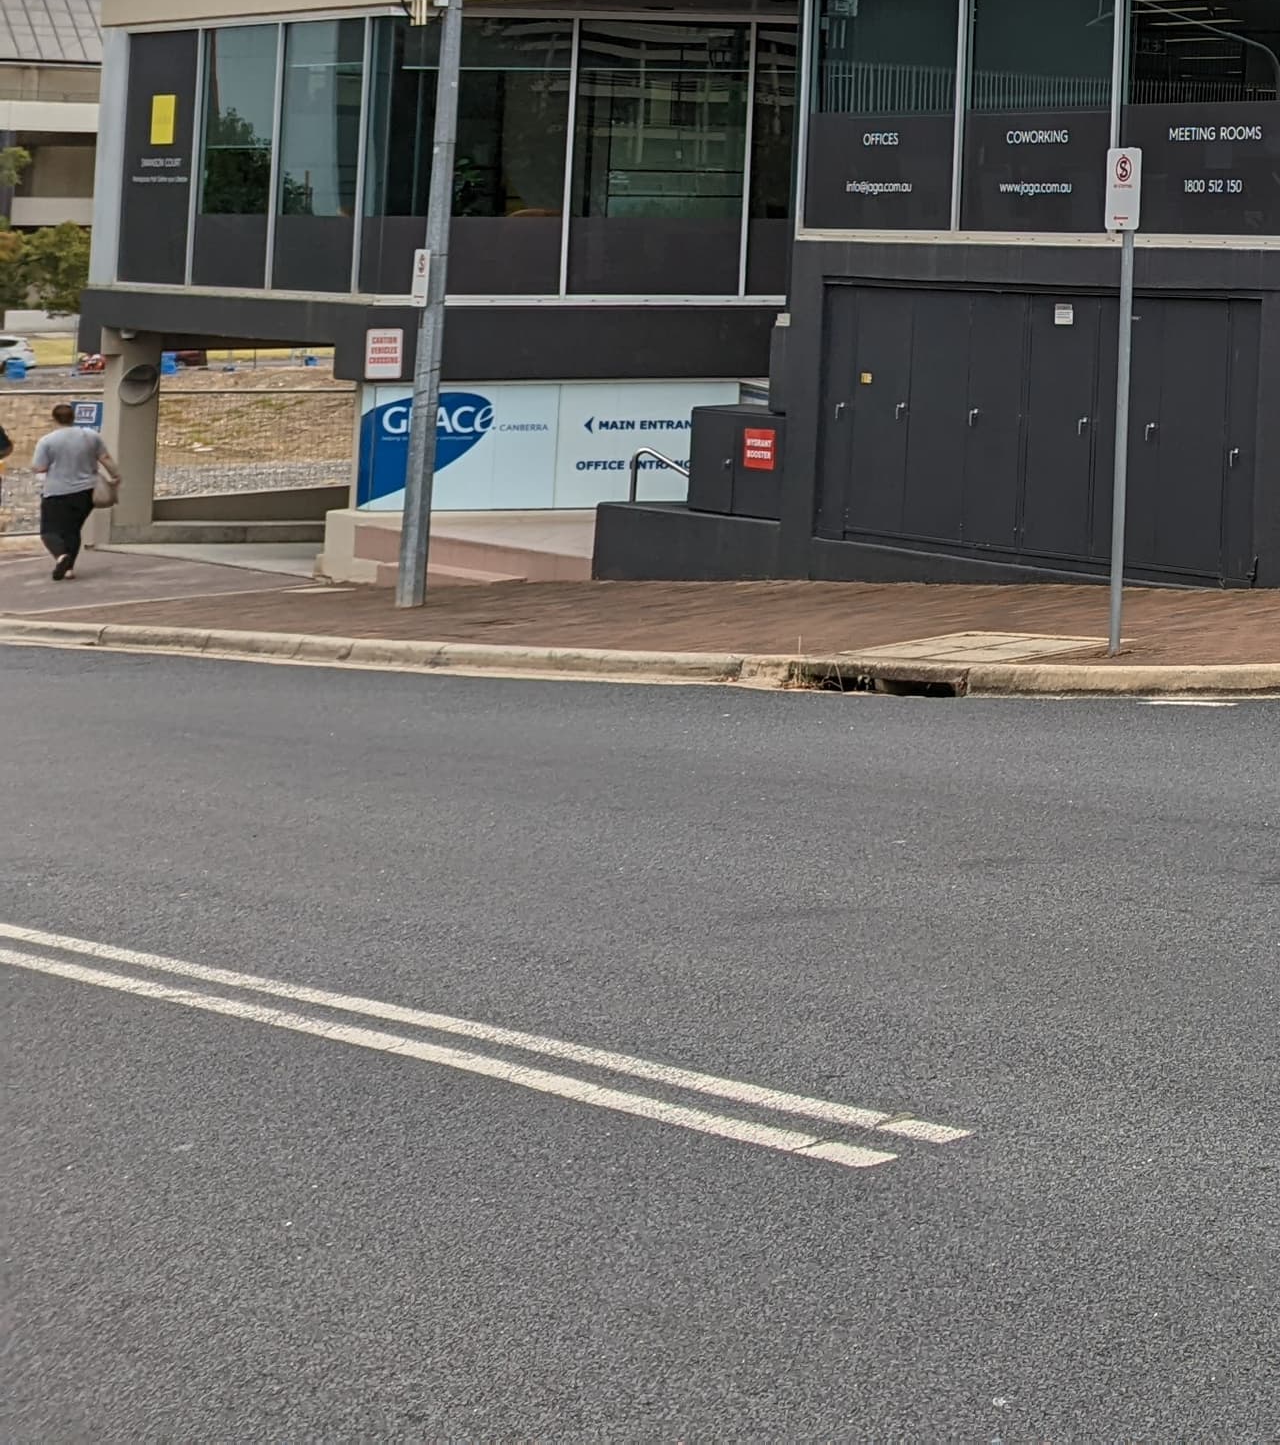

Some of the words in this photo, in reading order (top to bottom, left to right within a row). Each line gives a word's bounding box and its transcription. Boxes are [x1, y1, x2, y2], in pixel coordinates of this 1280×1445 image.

[863, 132, 899, 146] OFFICES
[1006, 130, 1069, 144] COWORKING
[1169, 127, 1216, 141] MEETING
[1220, 126, 1262, 140] ROOMS
[845, 180, 912, 195] info@jaga.com.au
[1000, 180, 1073, 196] www.jaga.com.au
[1184, 179, 1205, 193] 1800
[1207, 179, 1224, 193] 512
[1226, 179, 1243, 193] 150
[499, 423, 548, 432] CANBERRA
[599, 419, 635, 430] MAIN
[576, 460, 624, 471] OFFICE
